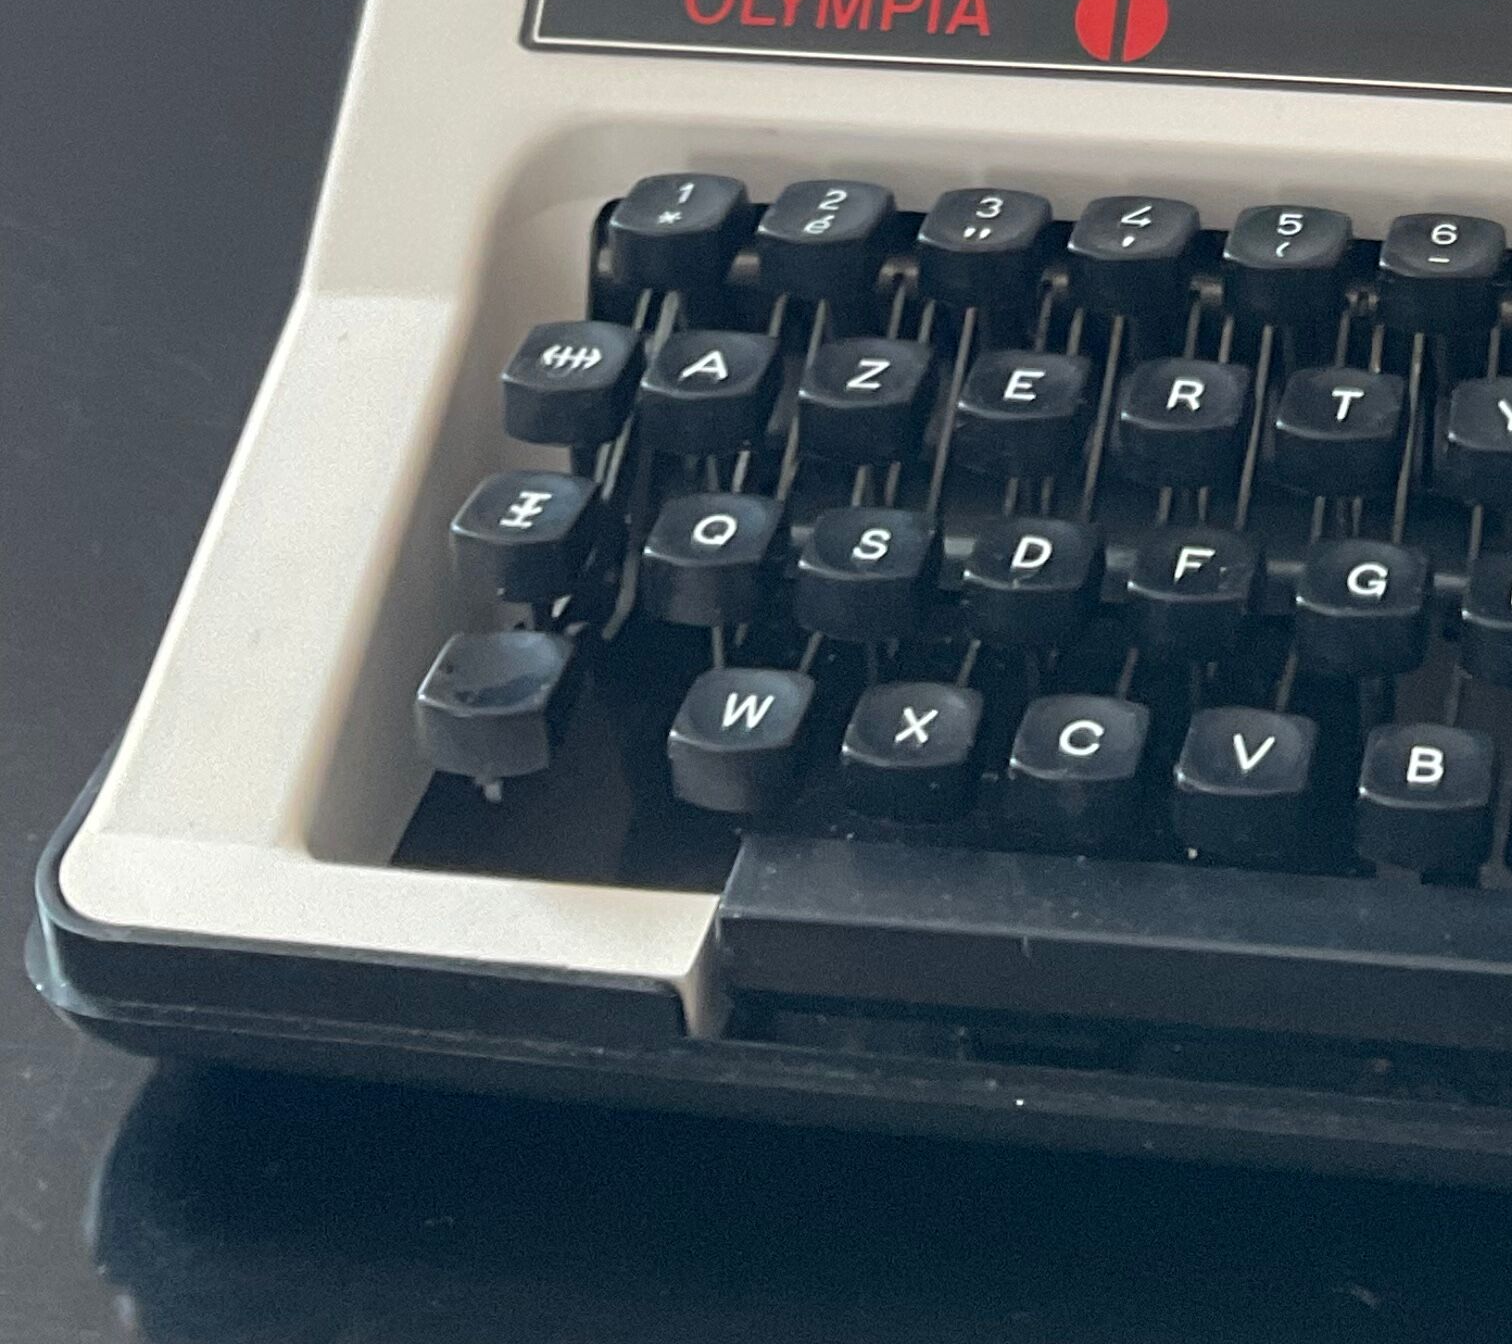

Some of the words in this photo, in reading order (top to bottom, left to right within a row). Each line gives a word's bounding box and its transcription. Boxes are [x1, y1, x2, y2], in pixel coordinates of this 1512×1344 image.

[678, 182, 695, 204] 1
[818, 189, 848, 211] 2
[975, 196, 1004, 218] 3
[1120, 205, 1152, 227] 4
[1277, 213, 1303, 236] 5
[1431, 223, 1457, 245] 6
[680, 350, 728, 380] A
[846, 359, 891, 390] Z
[1003, 369, 1046, 401] E
[1166, 378, 1205, 411] R
[1331, 388, 1365, 421] T
[852, 528, 891, 560] S
[1011, 536, 1052, 569] D
[1174, 546, 1216, 581] F
[1347, 563, 1388, 597] G
[722, 692, 775, 729] W
[895, 707, 939, 744] X
[1059, 719, 1105, 756] C
[1233, 733, 1276, 773] V
[1406, 746, 1444, 783] B
